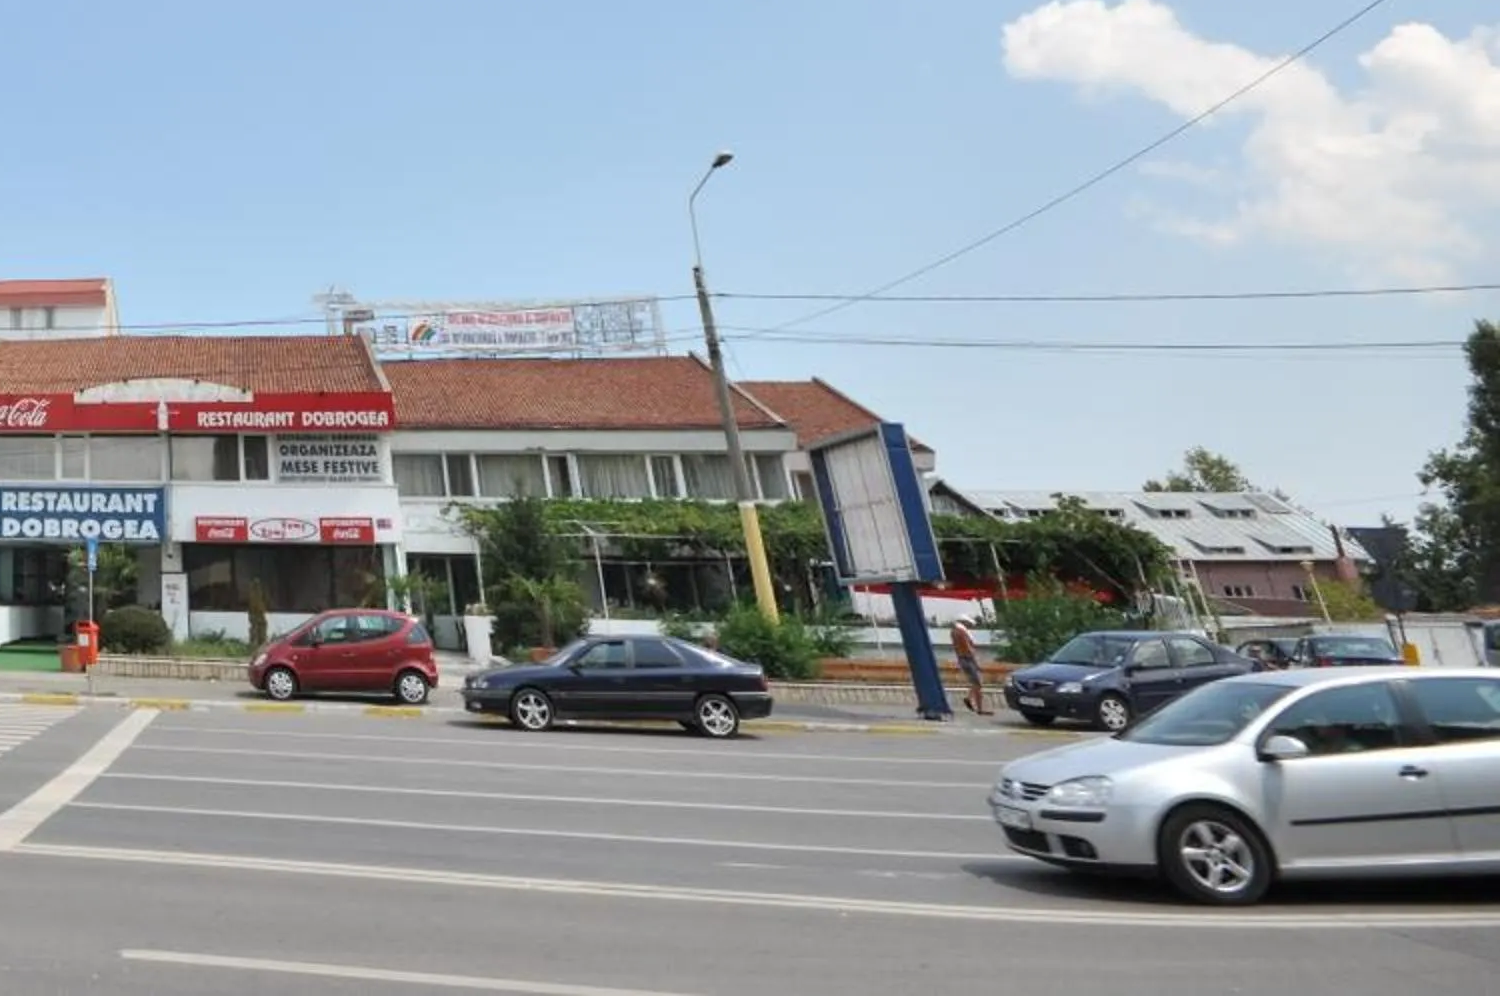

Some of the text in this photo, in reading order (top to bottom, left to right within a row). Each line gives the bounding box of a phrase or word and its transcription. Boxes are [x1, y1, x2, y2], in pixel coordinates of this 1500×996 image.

[197, 411, 389, 427] RESTAURANT DOBROGEA
[279, 444, 377, 457] ORGANIZEAZA
[281, 461, 380, 474] MESE FESTIVE
[1, 491, 158, 513] RESTAURANT
[1, 517, 160, 539] DOBROGEA
